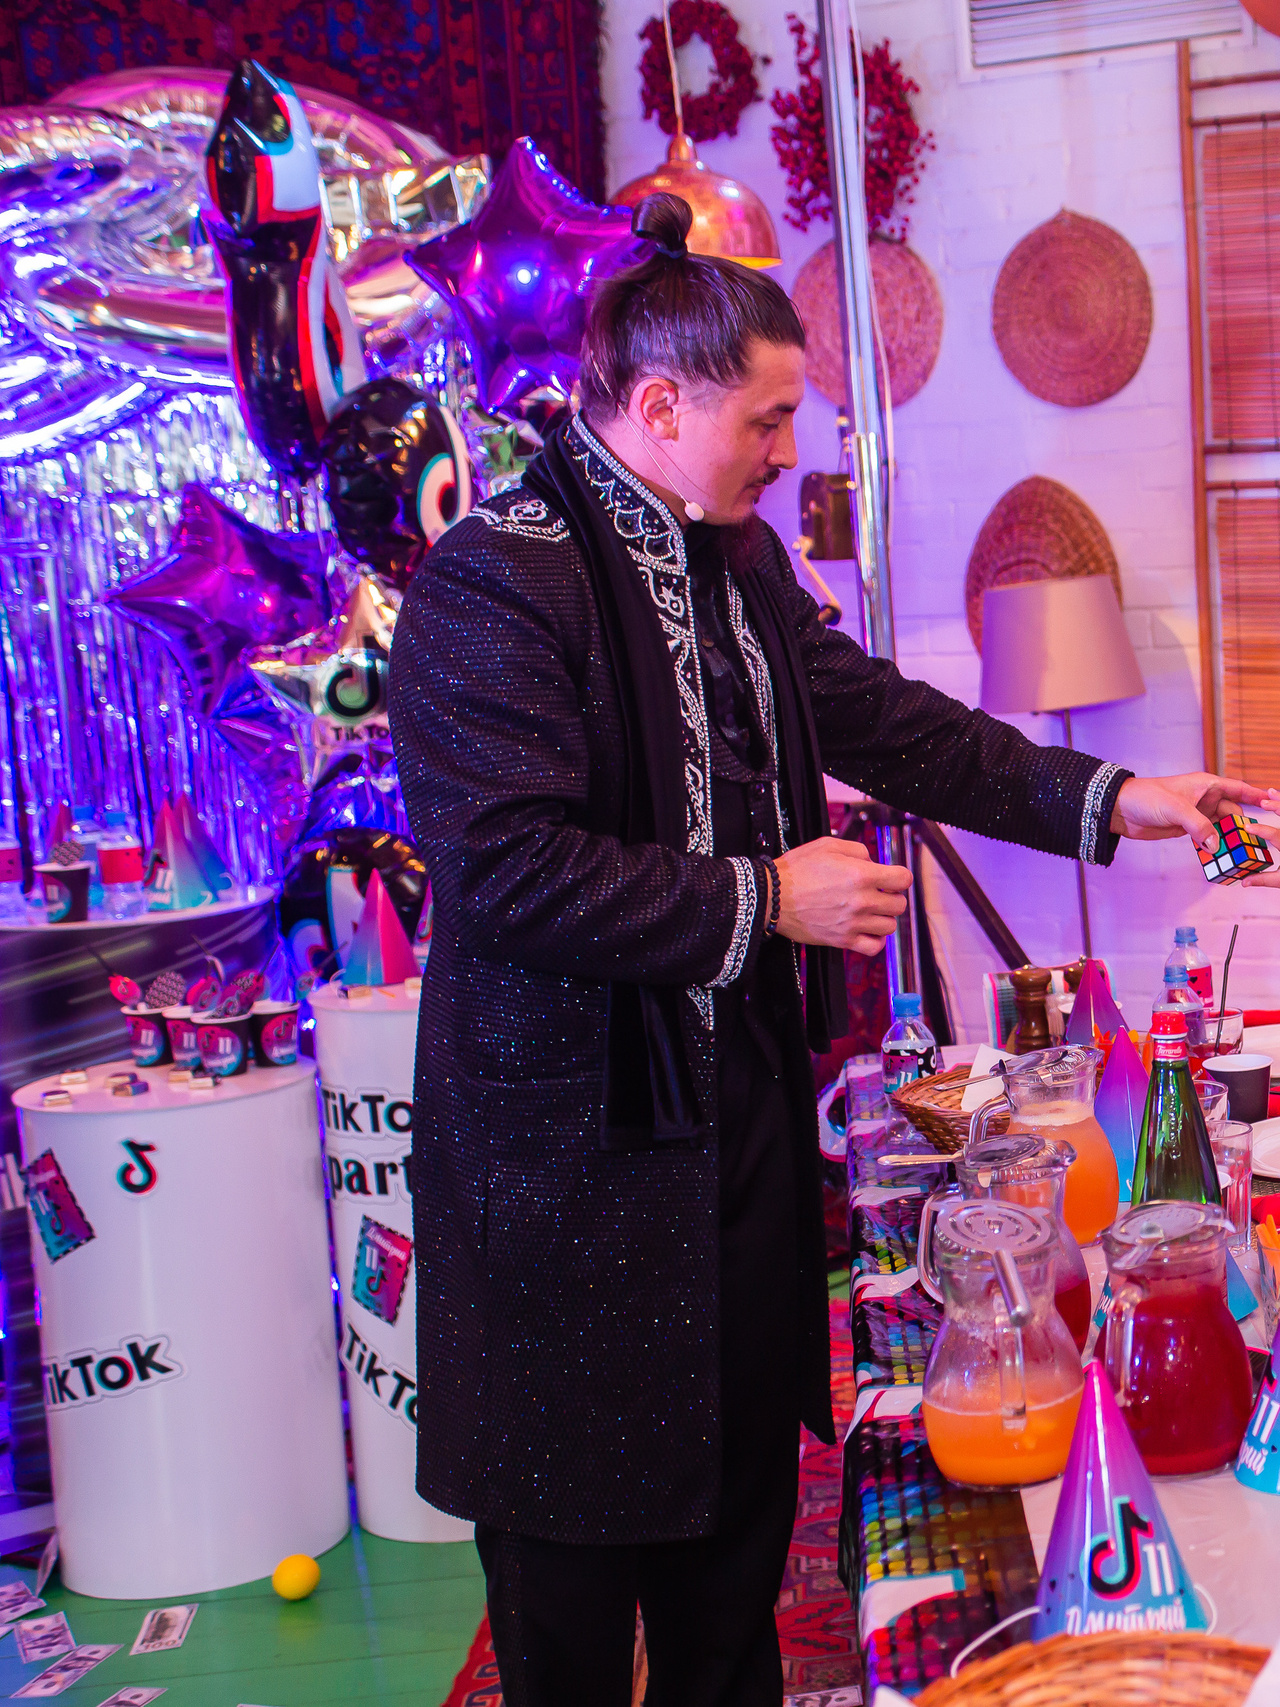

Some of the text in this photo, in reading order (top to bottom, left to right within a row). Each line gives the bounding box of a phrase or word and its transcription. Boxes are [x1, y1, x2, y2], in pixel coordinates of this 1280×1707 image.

[330, 724, 390, 741] TikTo
[322, 1089, 413, 1133] TikTo
[47, 1342, 174, 1405] ikTok
[1252, 1394, 1280, 1445] 11
[1143, 1543, 1175, 1597] 11
